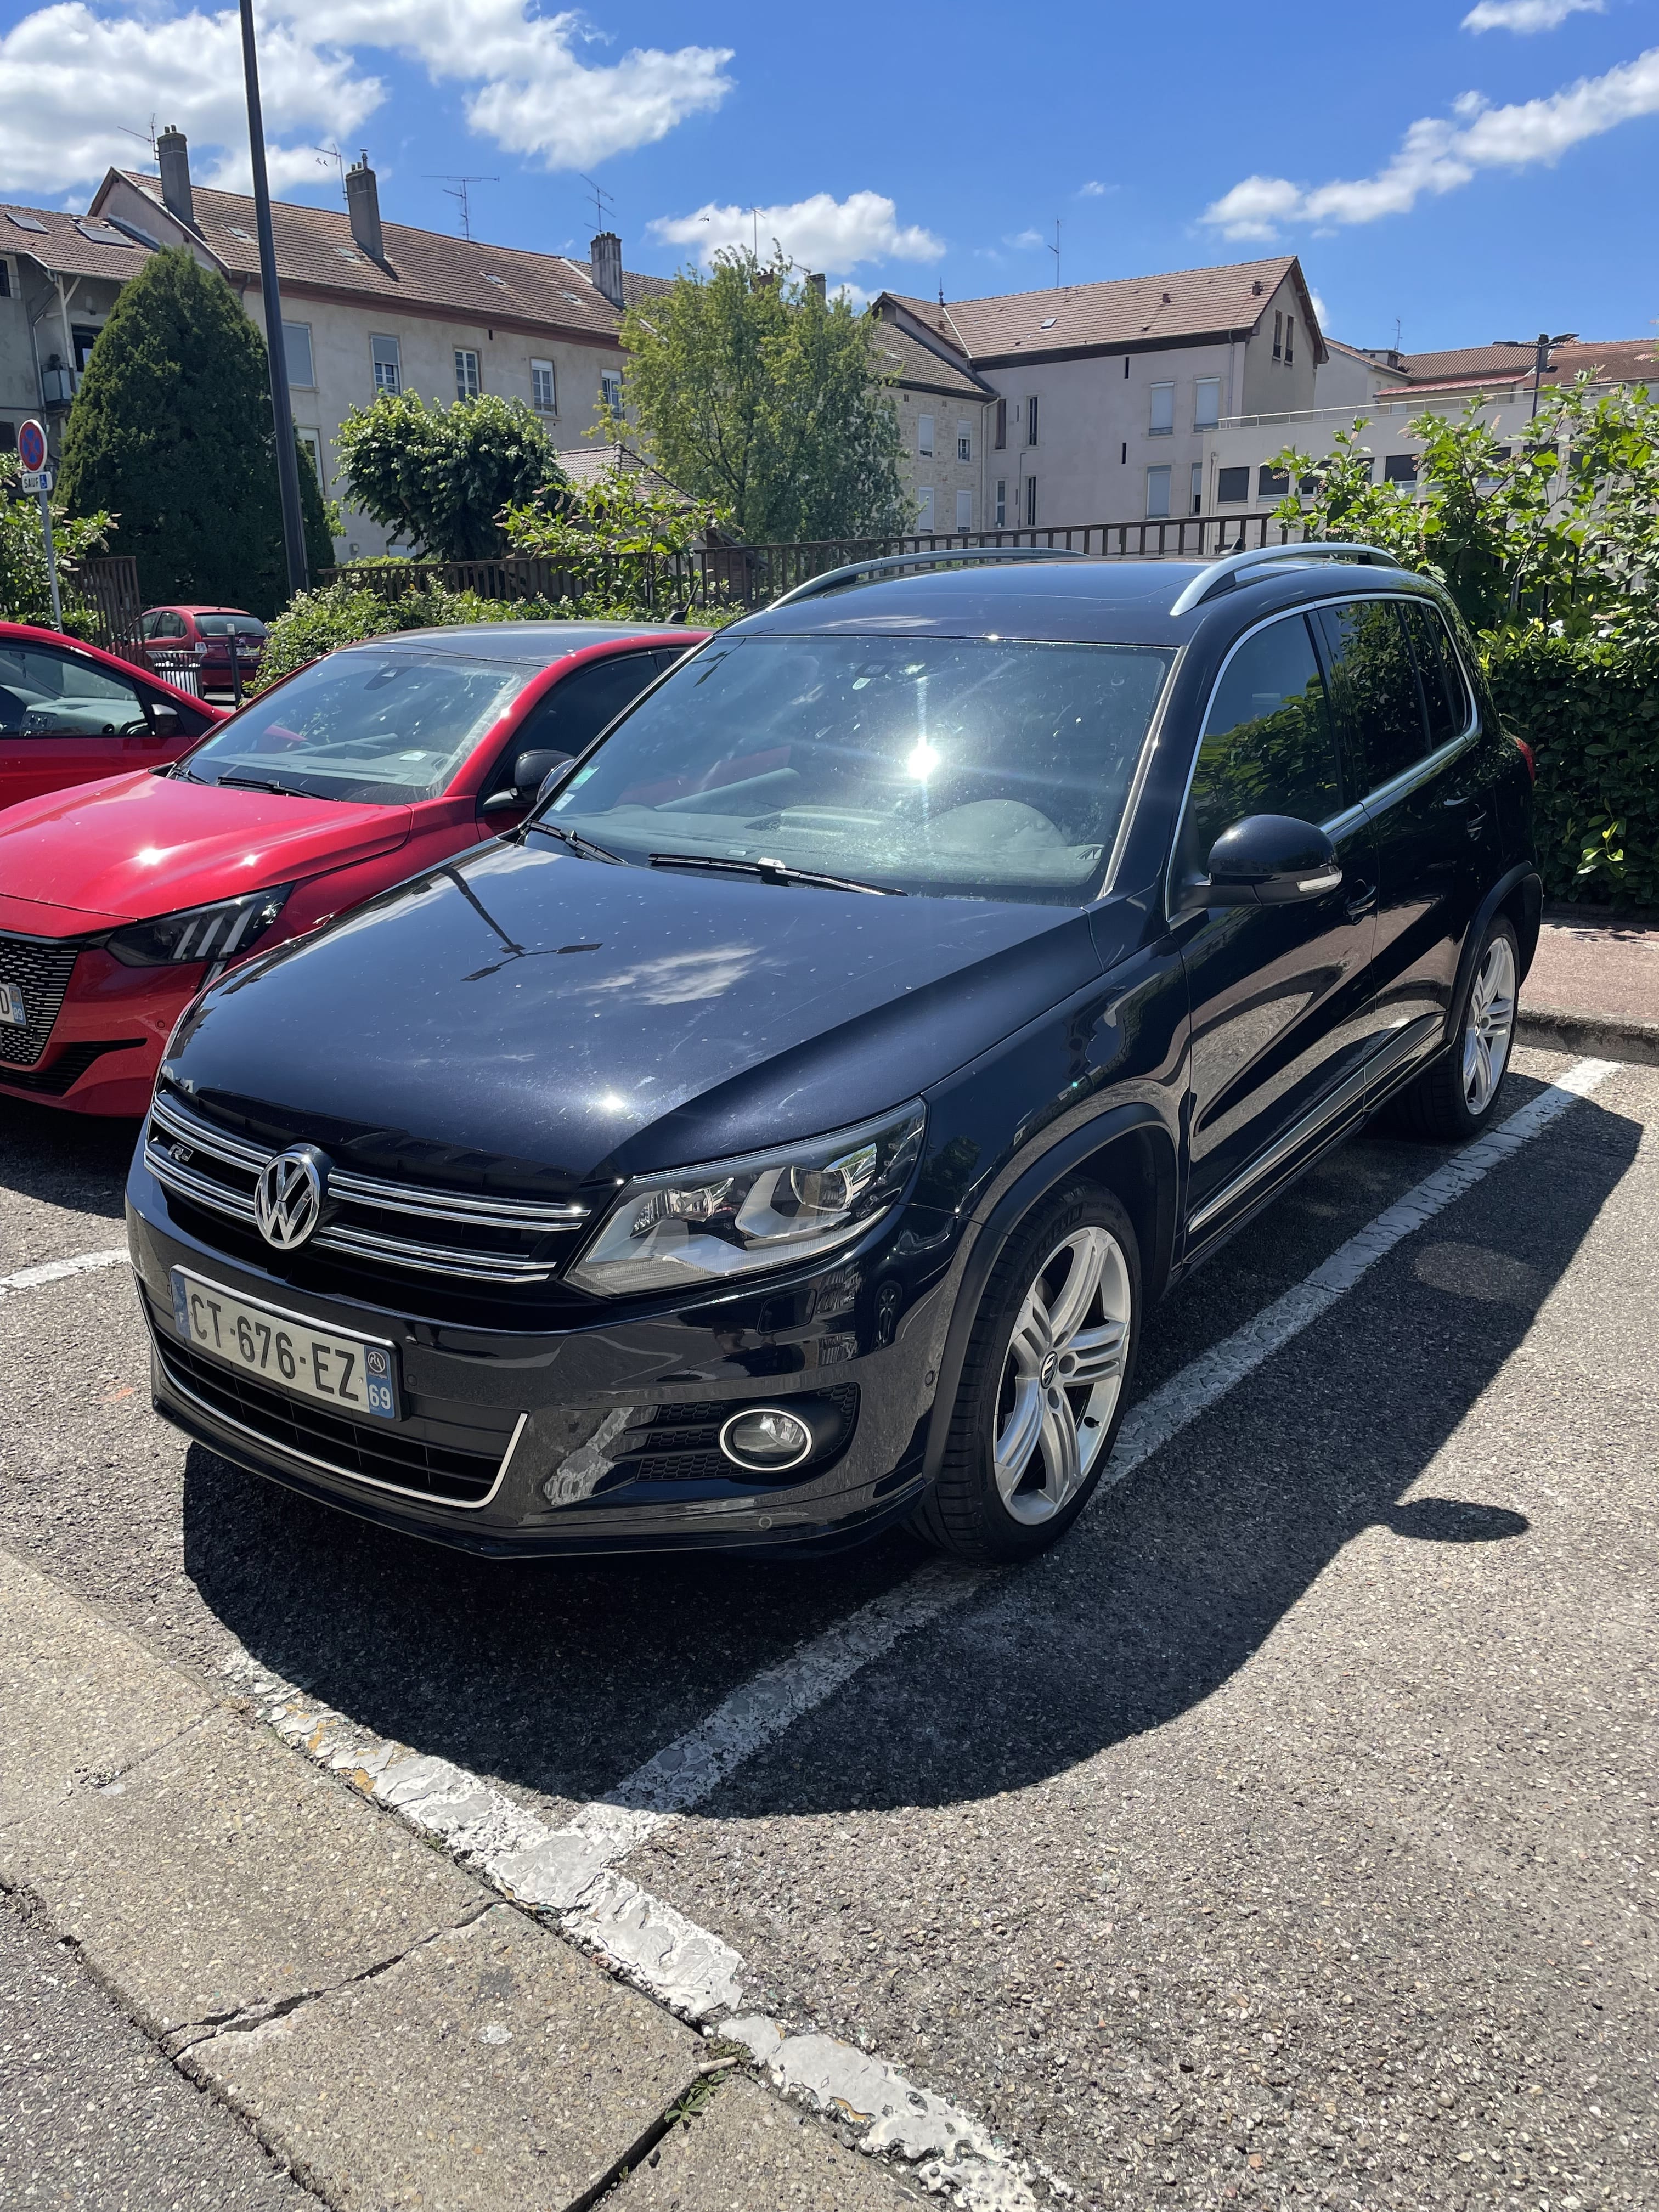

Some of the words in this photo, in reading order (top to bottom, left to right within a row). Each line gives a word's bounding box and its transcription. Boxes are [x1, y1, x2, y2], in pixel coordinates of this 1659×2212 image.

[24, 477, 38, 488] SAUF
[13, 1007, 23, 1020] 89
[369, 1384, 391, 1410] 69
